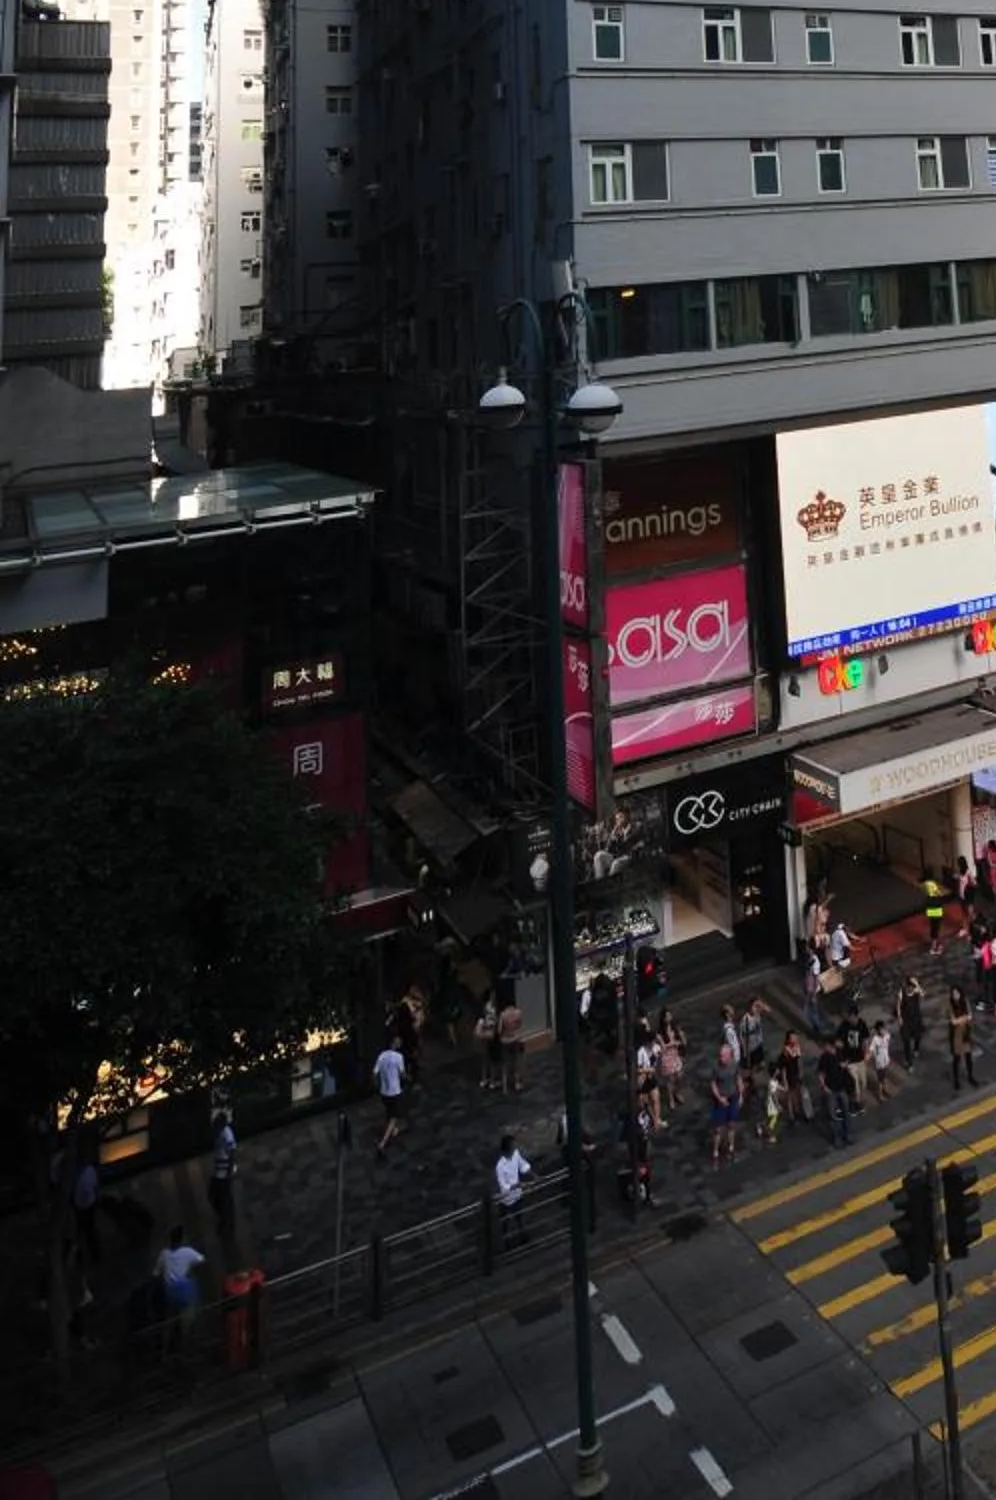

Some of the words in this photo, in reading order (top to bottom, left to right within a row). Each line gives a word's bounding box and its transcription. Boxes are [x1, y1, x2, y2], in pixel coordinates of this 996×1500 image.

[605, 503, 722, 543] annings
[859, 503, 924, 531] Emperor
[929, 495, 979, 517] Bullion
[608, 599, 730, 669] asa
[843, 631, 914, 656] NETWORK
[729, 806, 750, 821] CITY
[751, 798, 782, 815] CHAIN
